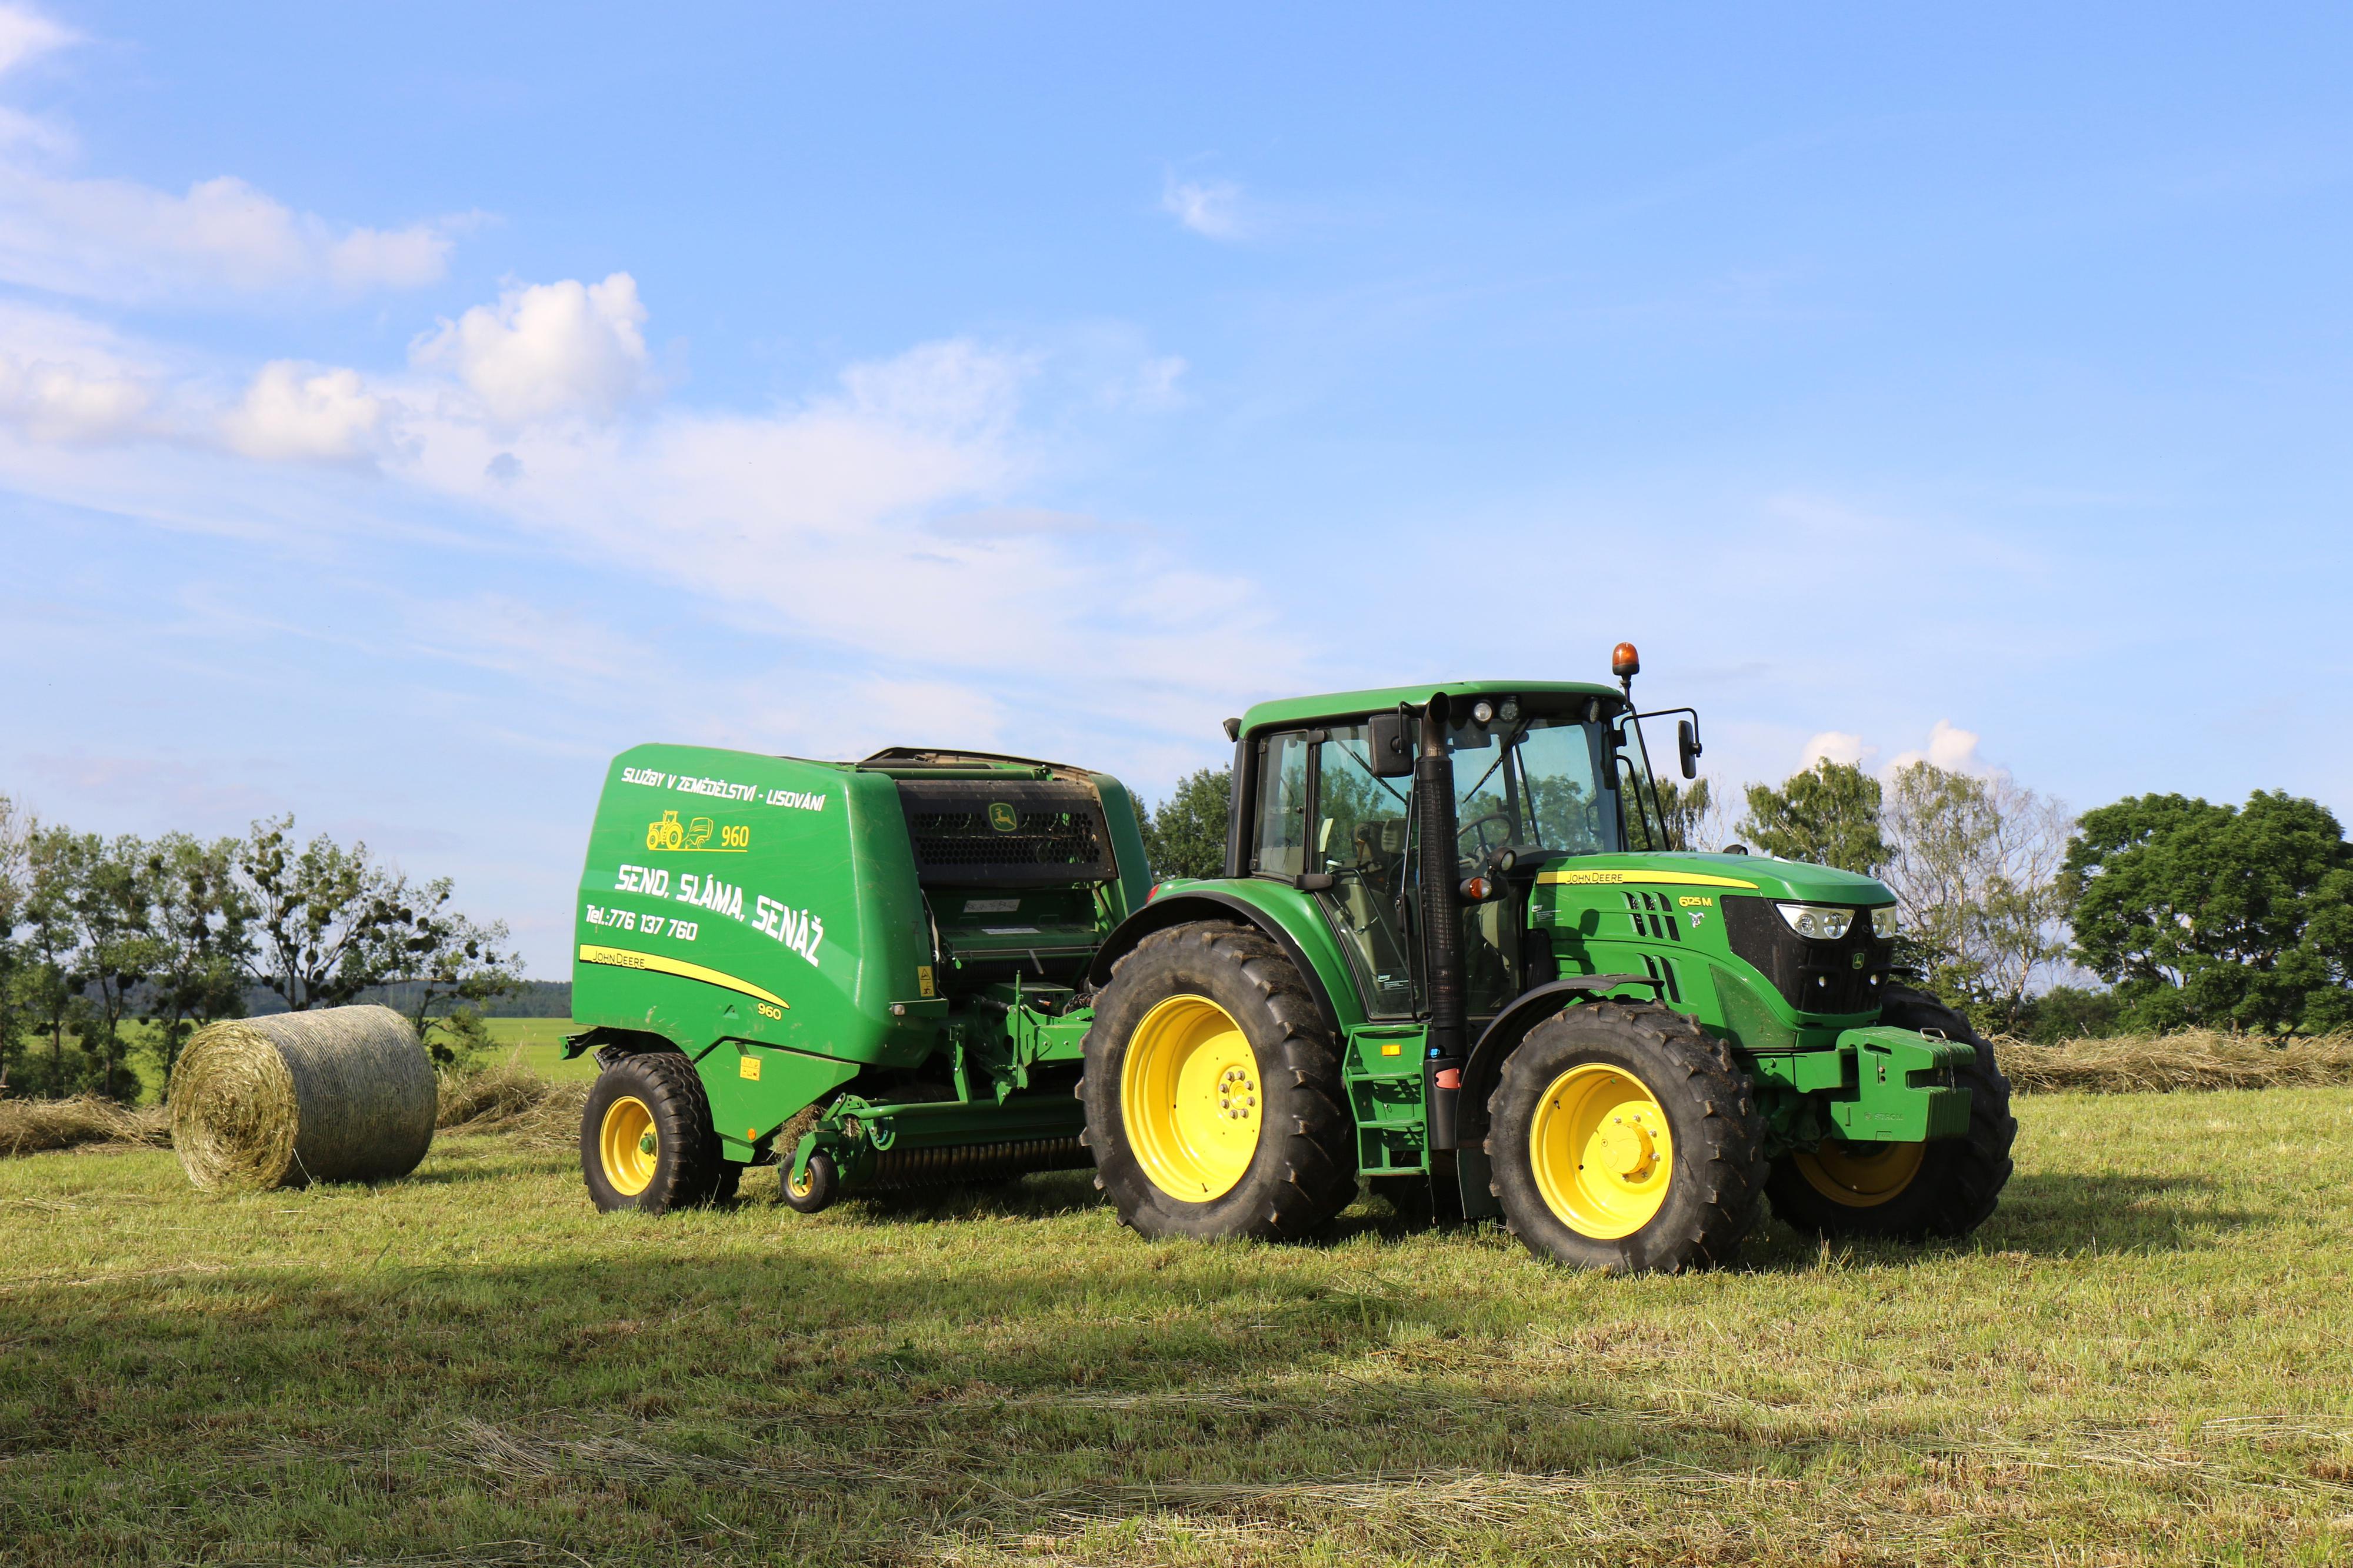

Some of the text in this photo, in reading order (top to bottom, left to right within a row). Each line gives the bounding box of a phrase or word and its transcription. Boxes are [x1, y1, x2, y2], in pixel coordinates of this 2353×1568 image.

[621, 767, 666, 788] SLUŽBY
[667, 774, 677, 789] V
[676, 776, 758, 802] ZEMĚDĚLSTVÍ
[766, 789, 826, 812] LISOVÁNÍ
[721, 825, 749, 848] 960
[1567, 873, 1622, 882] JOHN DEERE
[614, 864, 824, 968] SENO, SLÁMA, SENÁŽ
[640, 914, 665, 935] 137
[667, 919, 698, 941] 760
[593, 950, 645, 968] JOHN DEERE
[758, 1003, 782, 1020] 960
